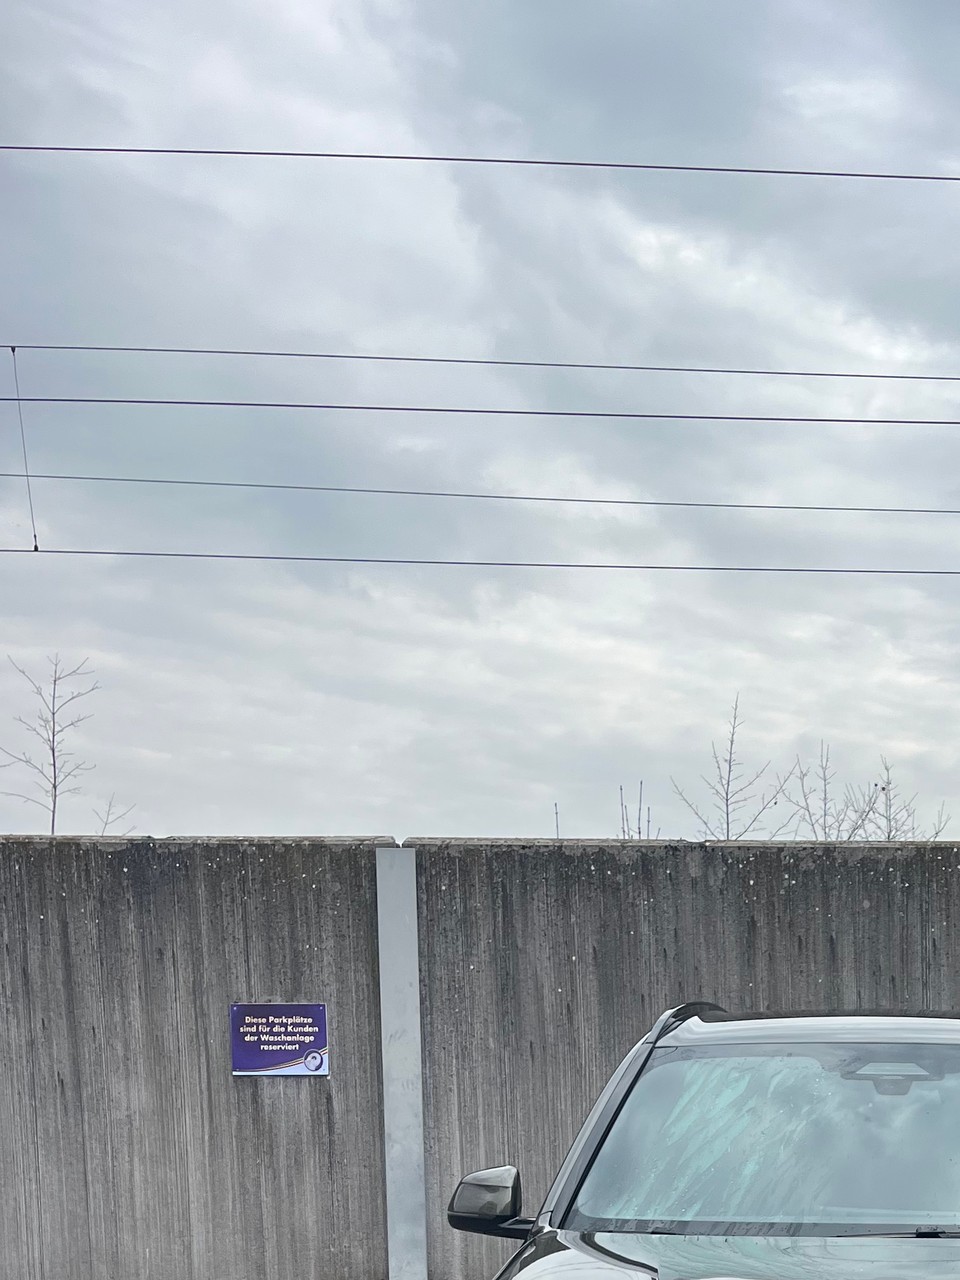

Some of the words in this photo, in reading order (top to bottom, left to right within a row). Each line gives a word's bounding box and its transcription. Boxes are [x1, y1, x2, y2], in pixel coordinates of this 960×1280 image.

[268, 1016, 313, 1025] Parkplätze
[239, 1025, 257, 1033] sind
[258, 1025, 270, 1033] für
[272, 1025, 286, 1033] die
[287, 1025, 319, 1033] Kunden
[244, 1034, 258, 1042] der
[260, 1034, 315, 1043] Waschanlage
[260, 1043, 299, 1051] reserviert
